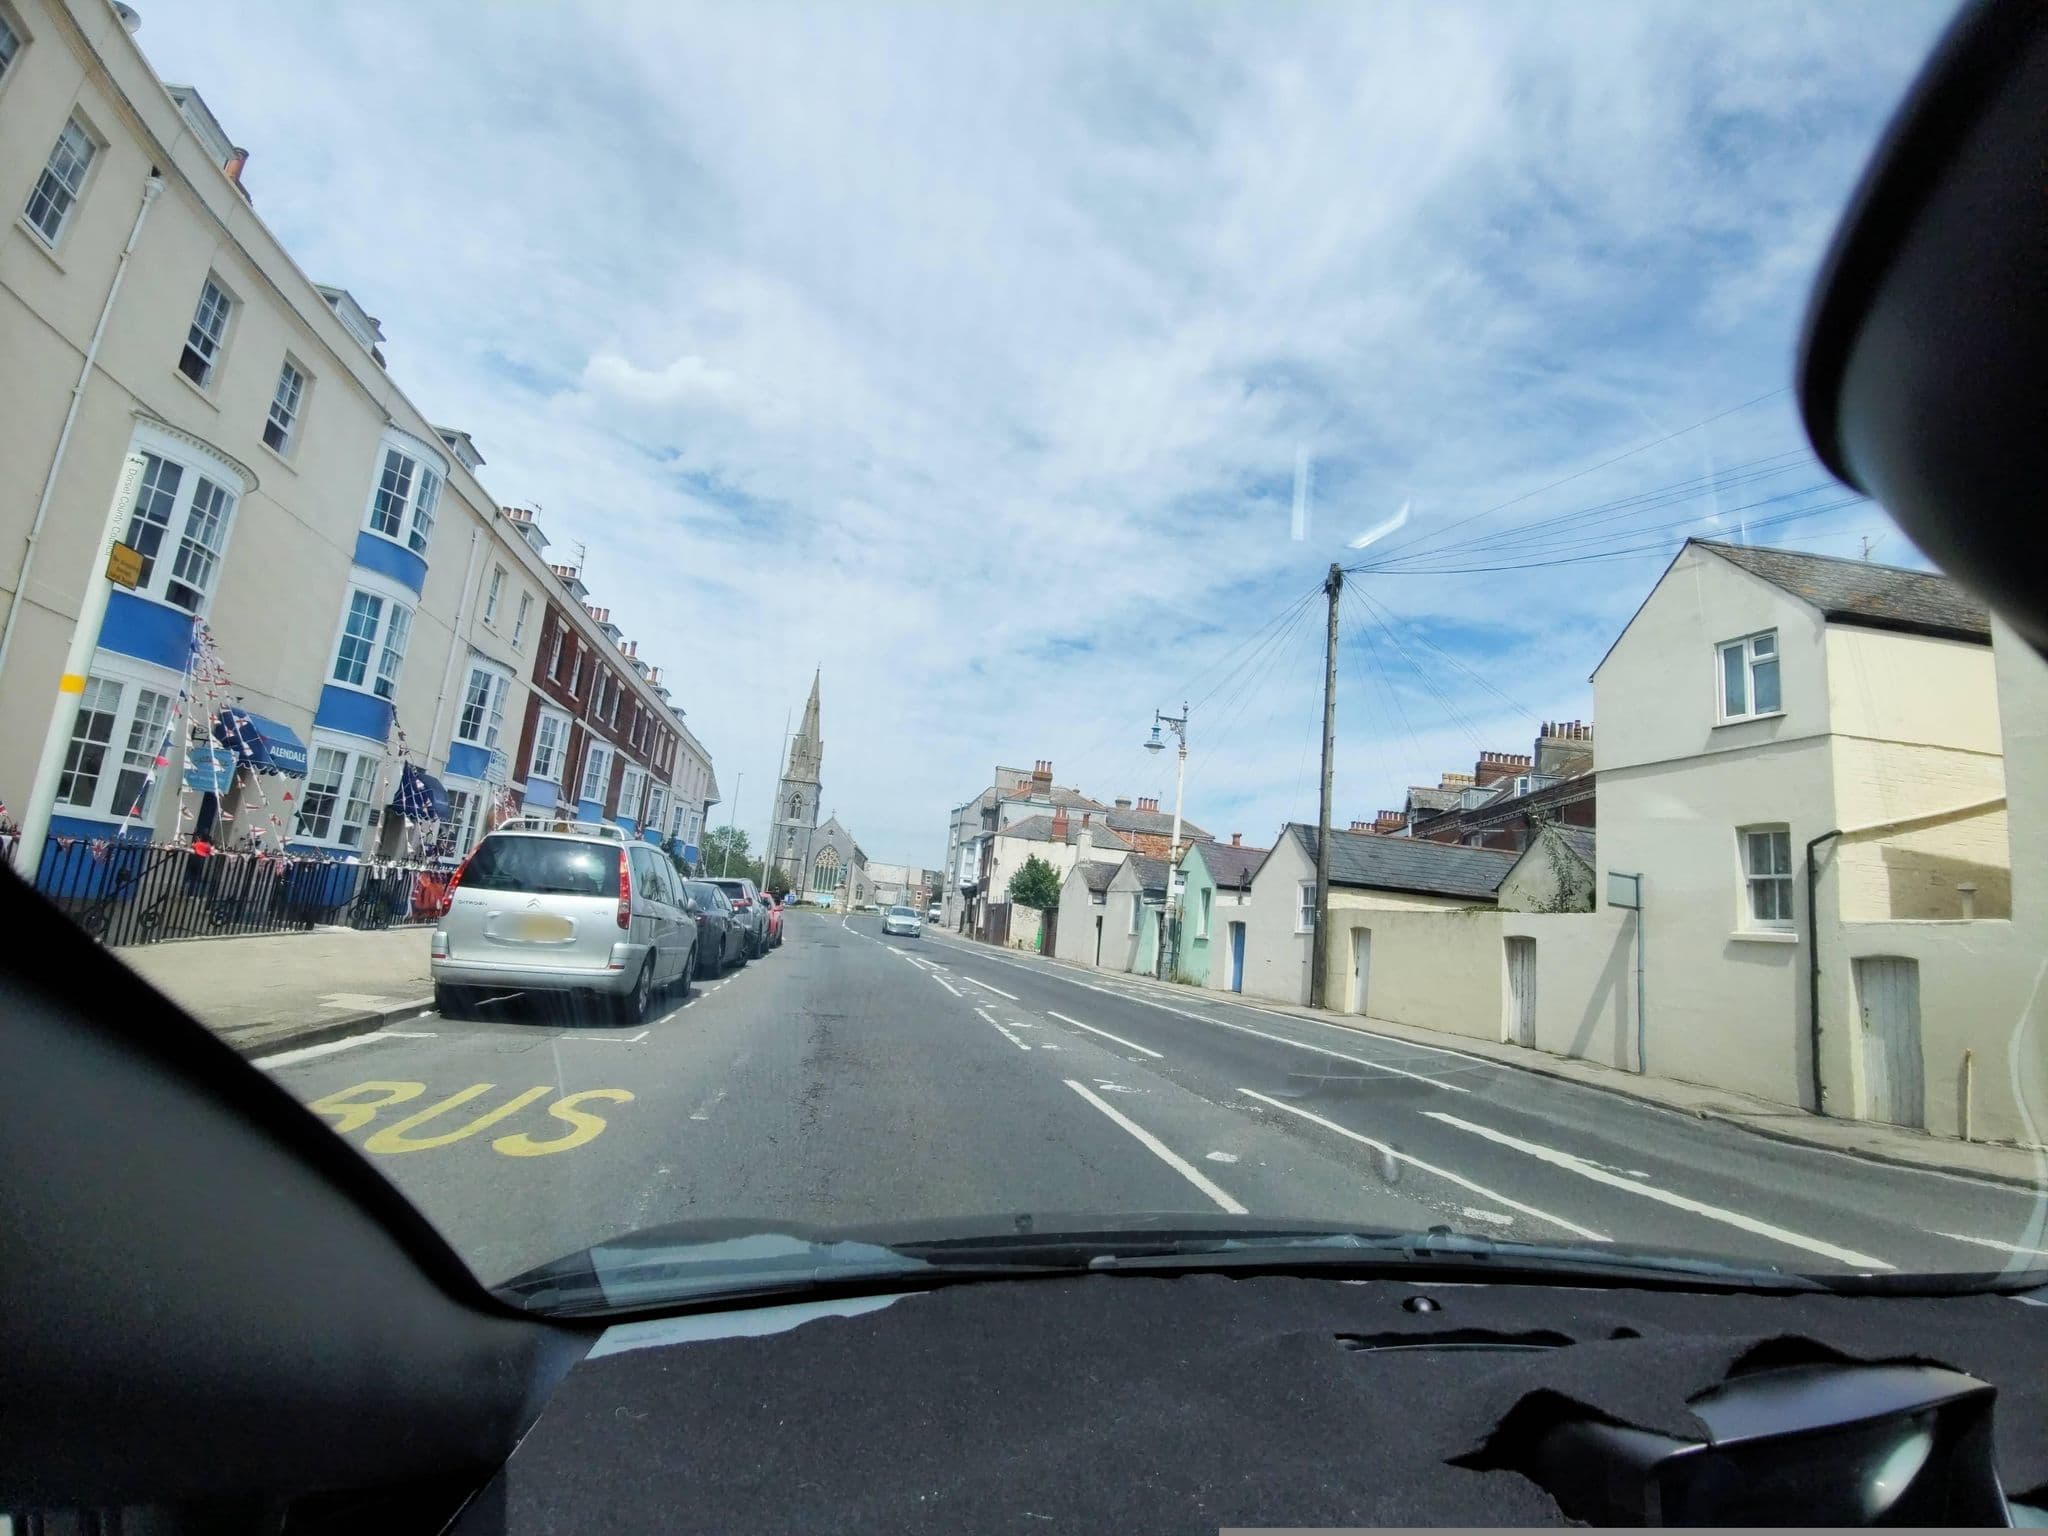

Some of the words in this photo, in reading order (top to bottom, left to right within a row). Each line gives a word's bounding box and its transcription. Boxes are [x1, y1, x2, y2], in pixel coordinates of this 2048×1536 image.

[120, 469, 137, 495] Dorset
[112, 496, 130, 524] County
[306, 1080, 635, 1157] BUS
